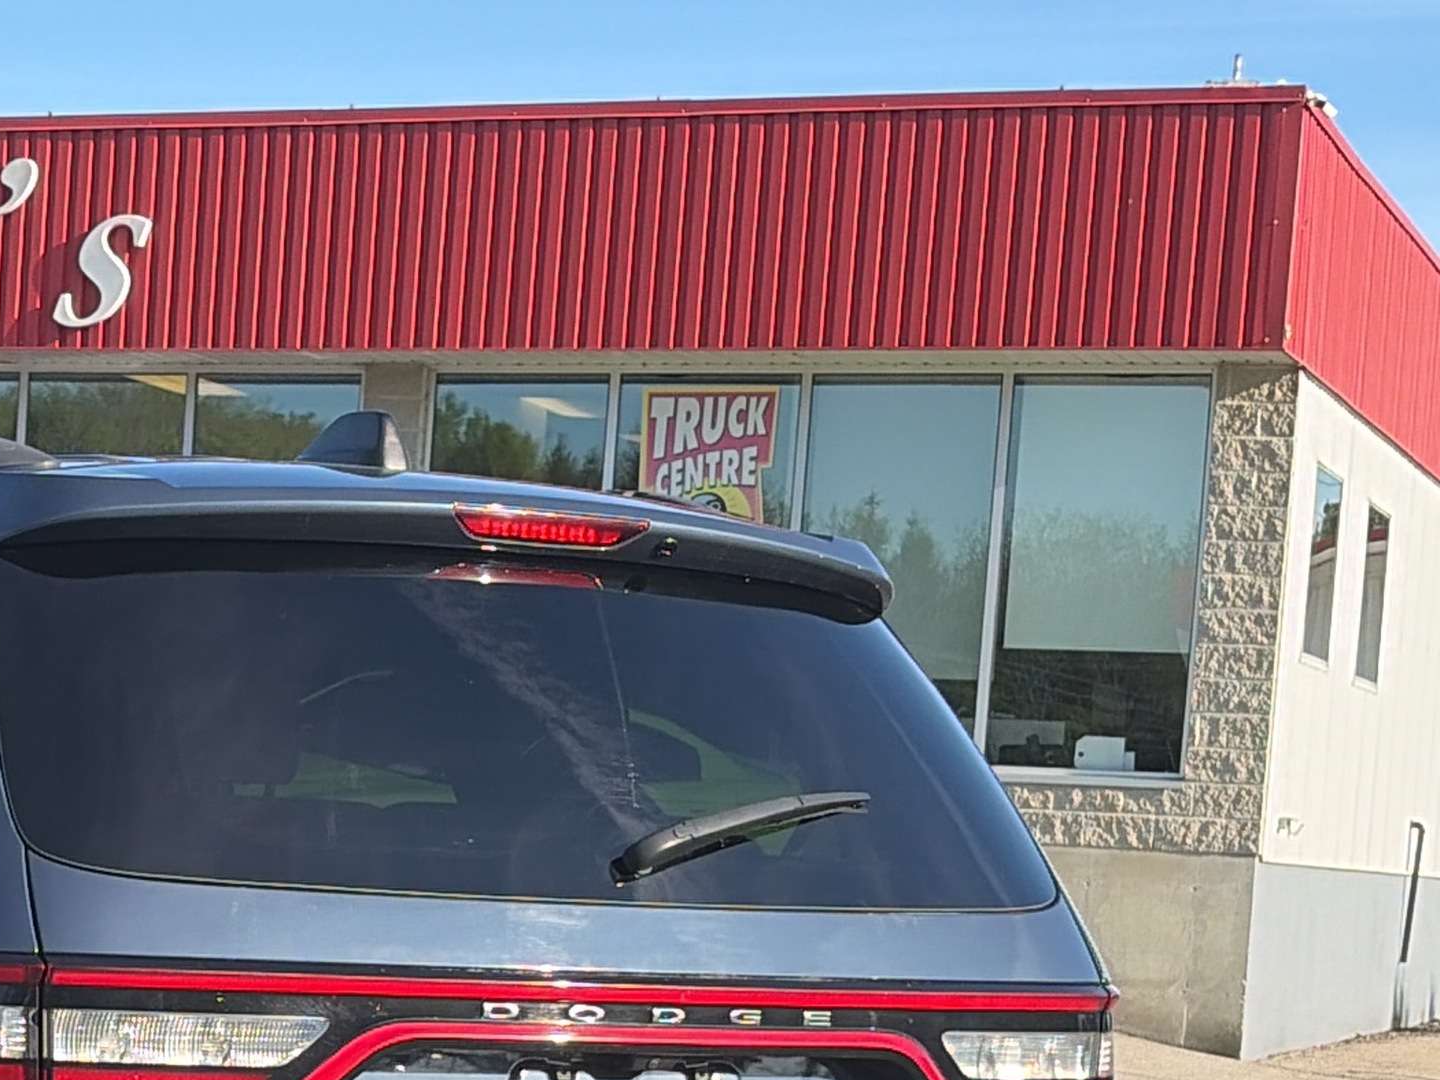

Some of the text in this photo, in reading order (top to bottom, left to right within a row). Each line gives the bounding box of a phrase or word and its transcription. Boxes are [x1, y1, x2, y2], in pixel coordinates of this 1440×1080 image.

[650, 395, 769, 460] TRUCK
[655, 446, 759, 498] CENTRE
[481, 1001, 833, 1028] DODGE
